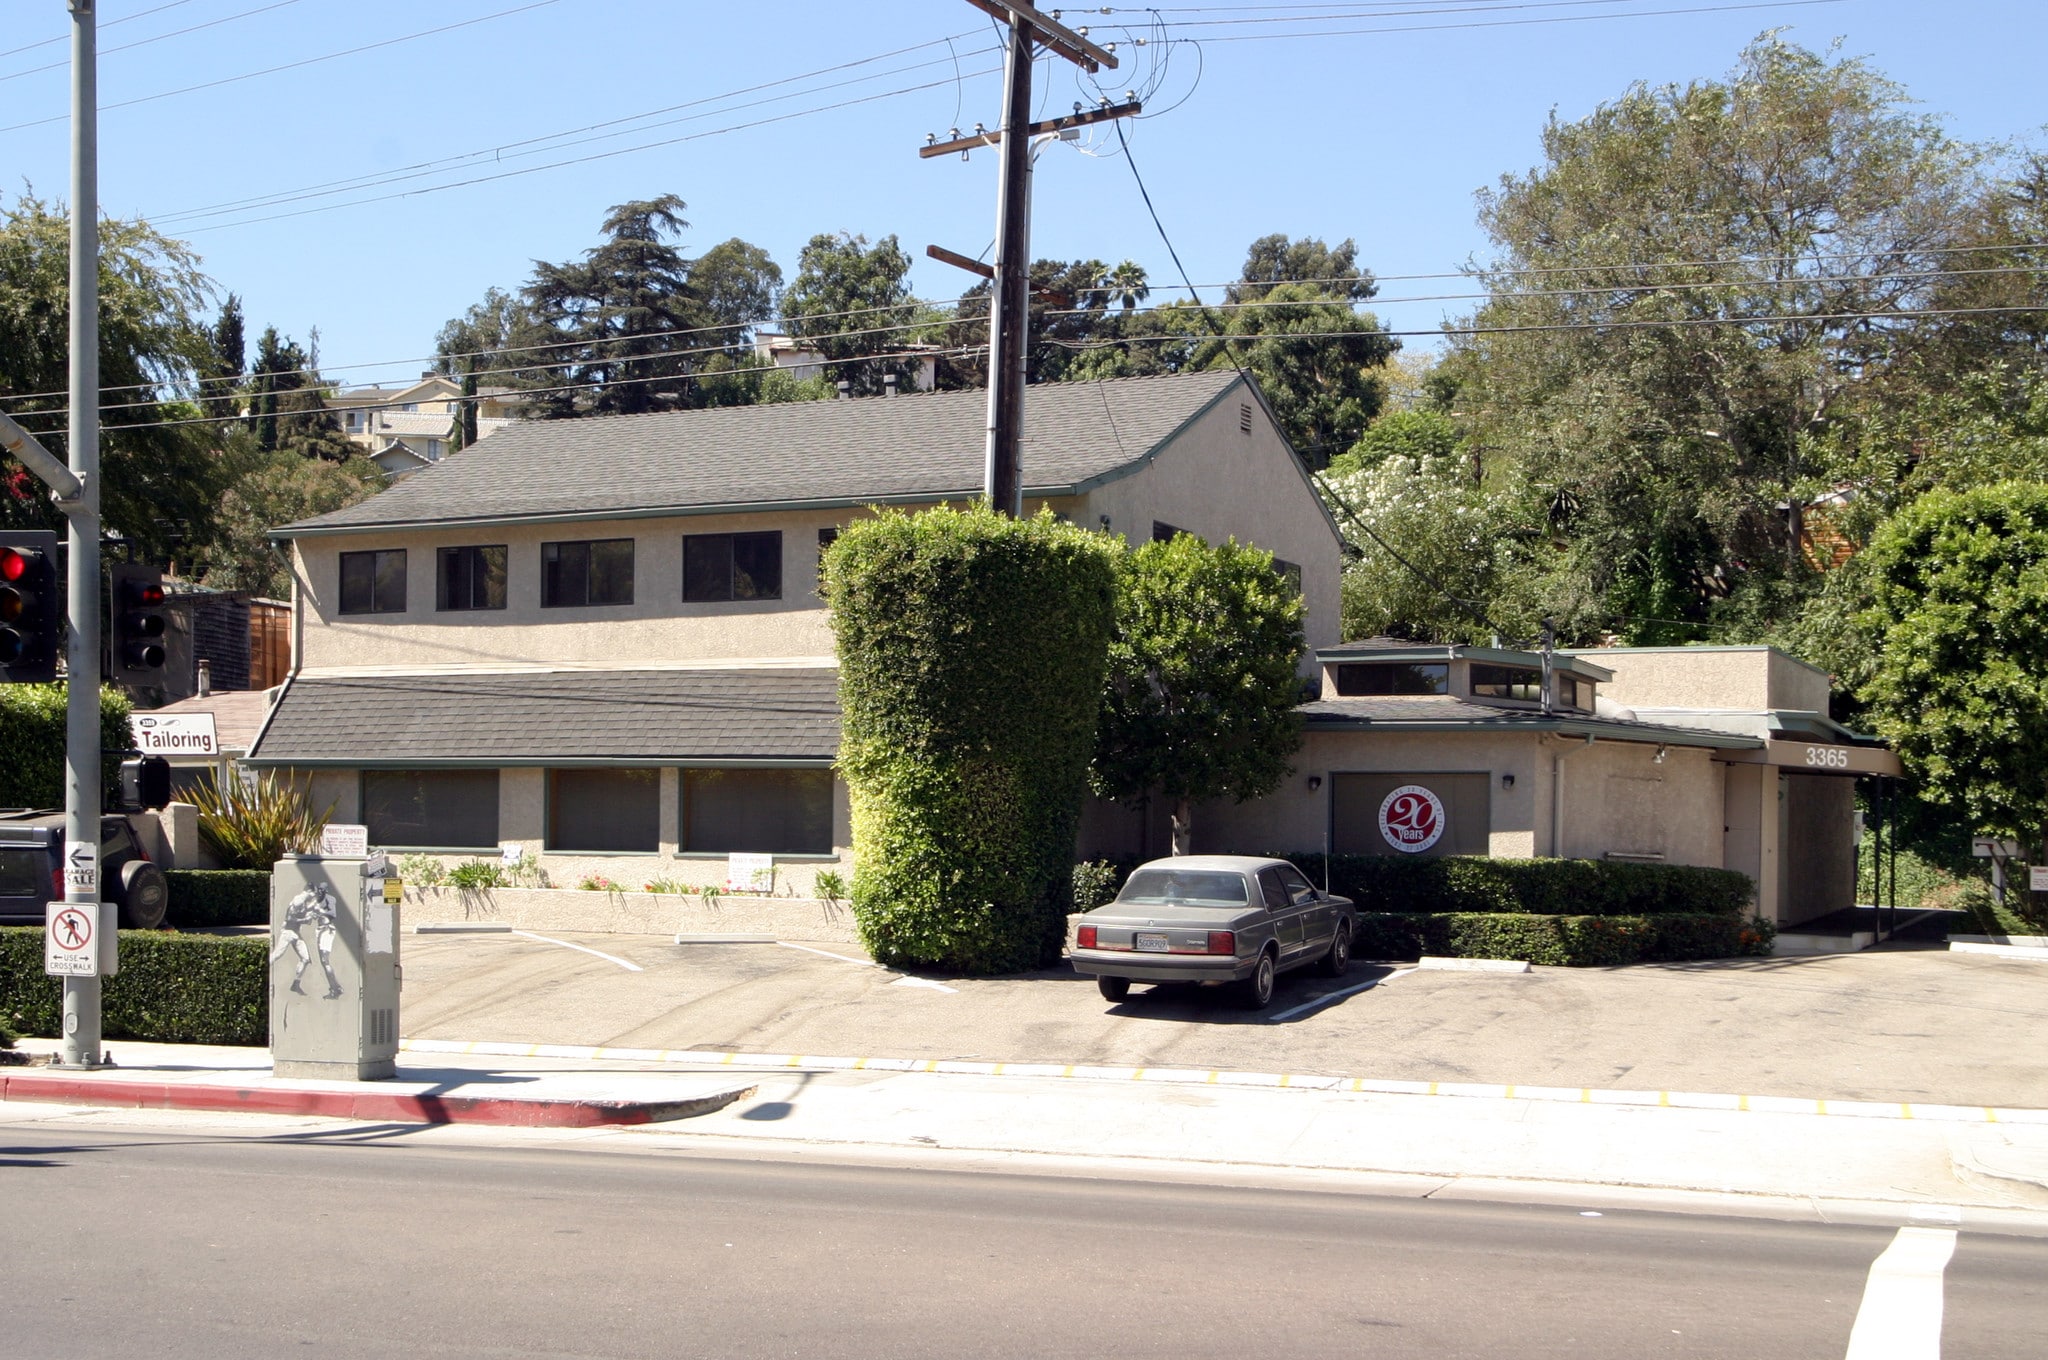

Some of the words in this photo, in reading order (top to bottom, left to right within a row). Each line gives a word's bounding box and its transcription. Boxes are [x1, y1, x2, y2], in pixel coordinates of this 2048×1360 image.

[142, 731, 211, 752] Tailoring
[1806, 747, 1847, 767] 3365
[1389, 797, 1436, 829] 20
[1393, 826, 1424, 841] Years
[66, 874, 95, 885] SALE
[50, 962, 92, 970] CROSSWALK
